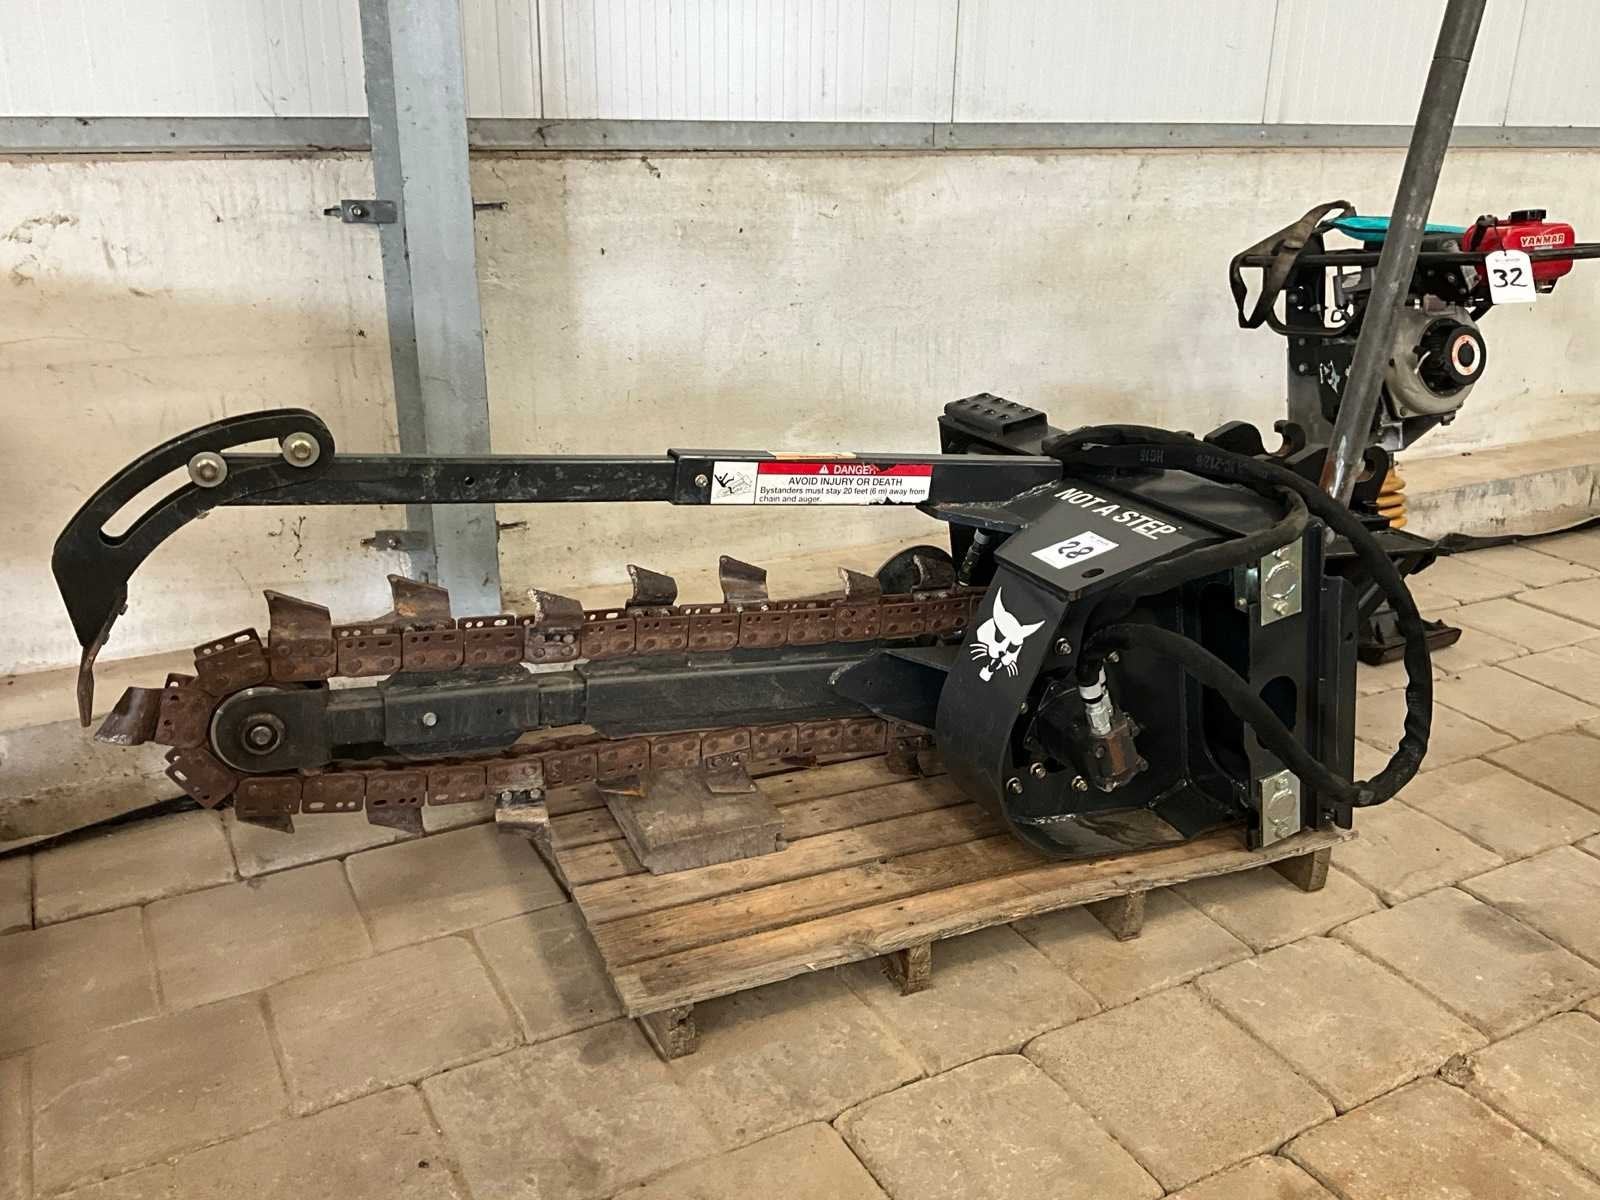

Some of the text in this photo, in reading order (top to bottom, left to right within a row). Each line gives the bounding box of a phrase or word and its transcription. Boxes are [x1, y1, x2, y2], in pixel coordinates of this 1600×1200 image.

[1521, 233, 1565, 247] YANMAR
[1493, 267, 1528, 287] 32
[788, 477, 903, 486] AVOID INJURY OR DEATH
[760, 486, 803, 495] Bystanders
[826, 487, 842, 495] stay
[1054, 487, 1177, 540] NOT A STEP
